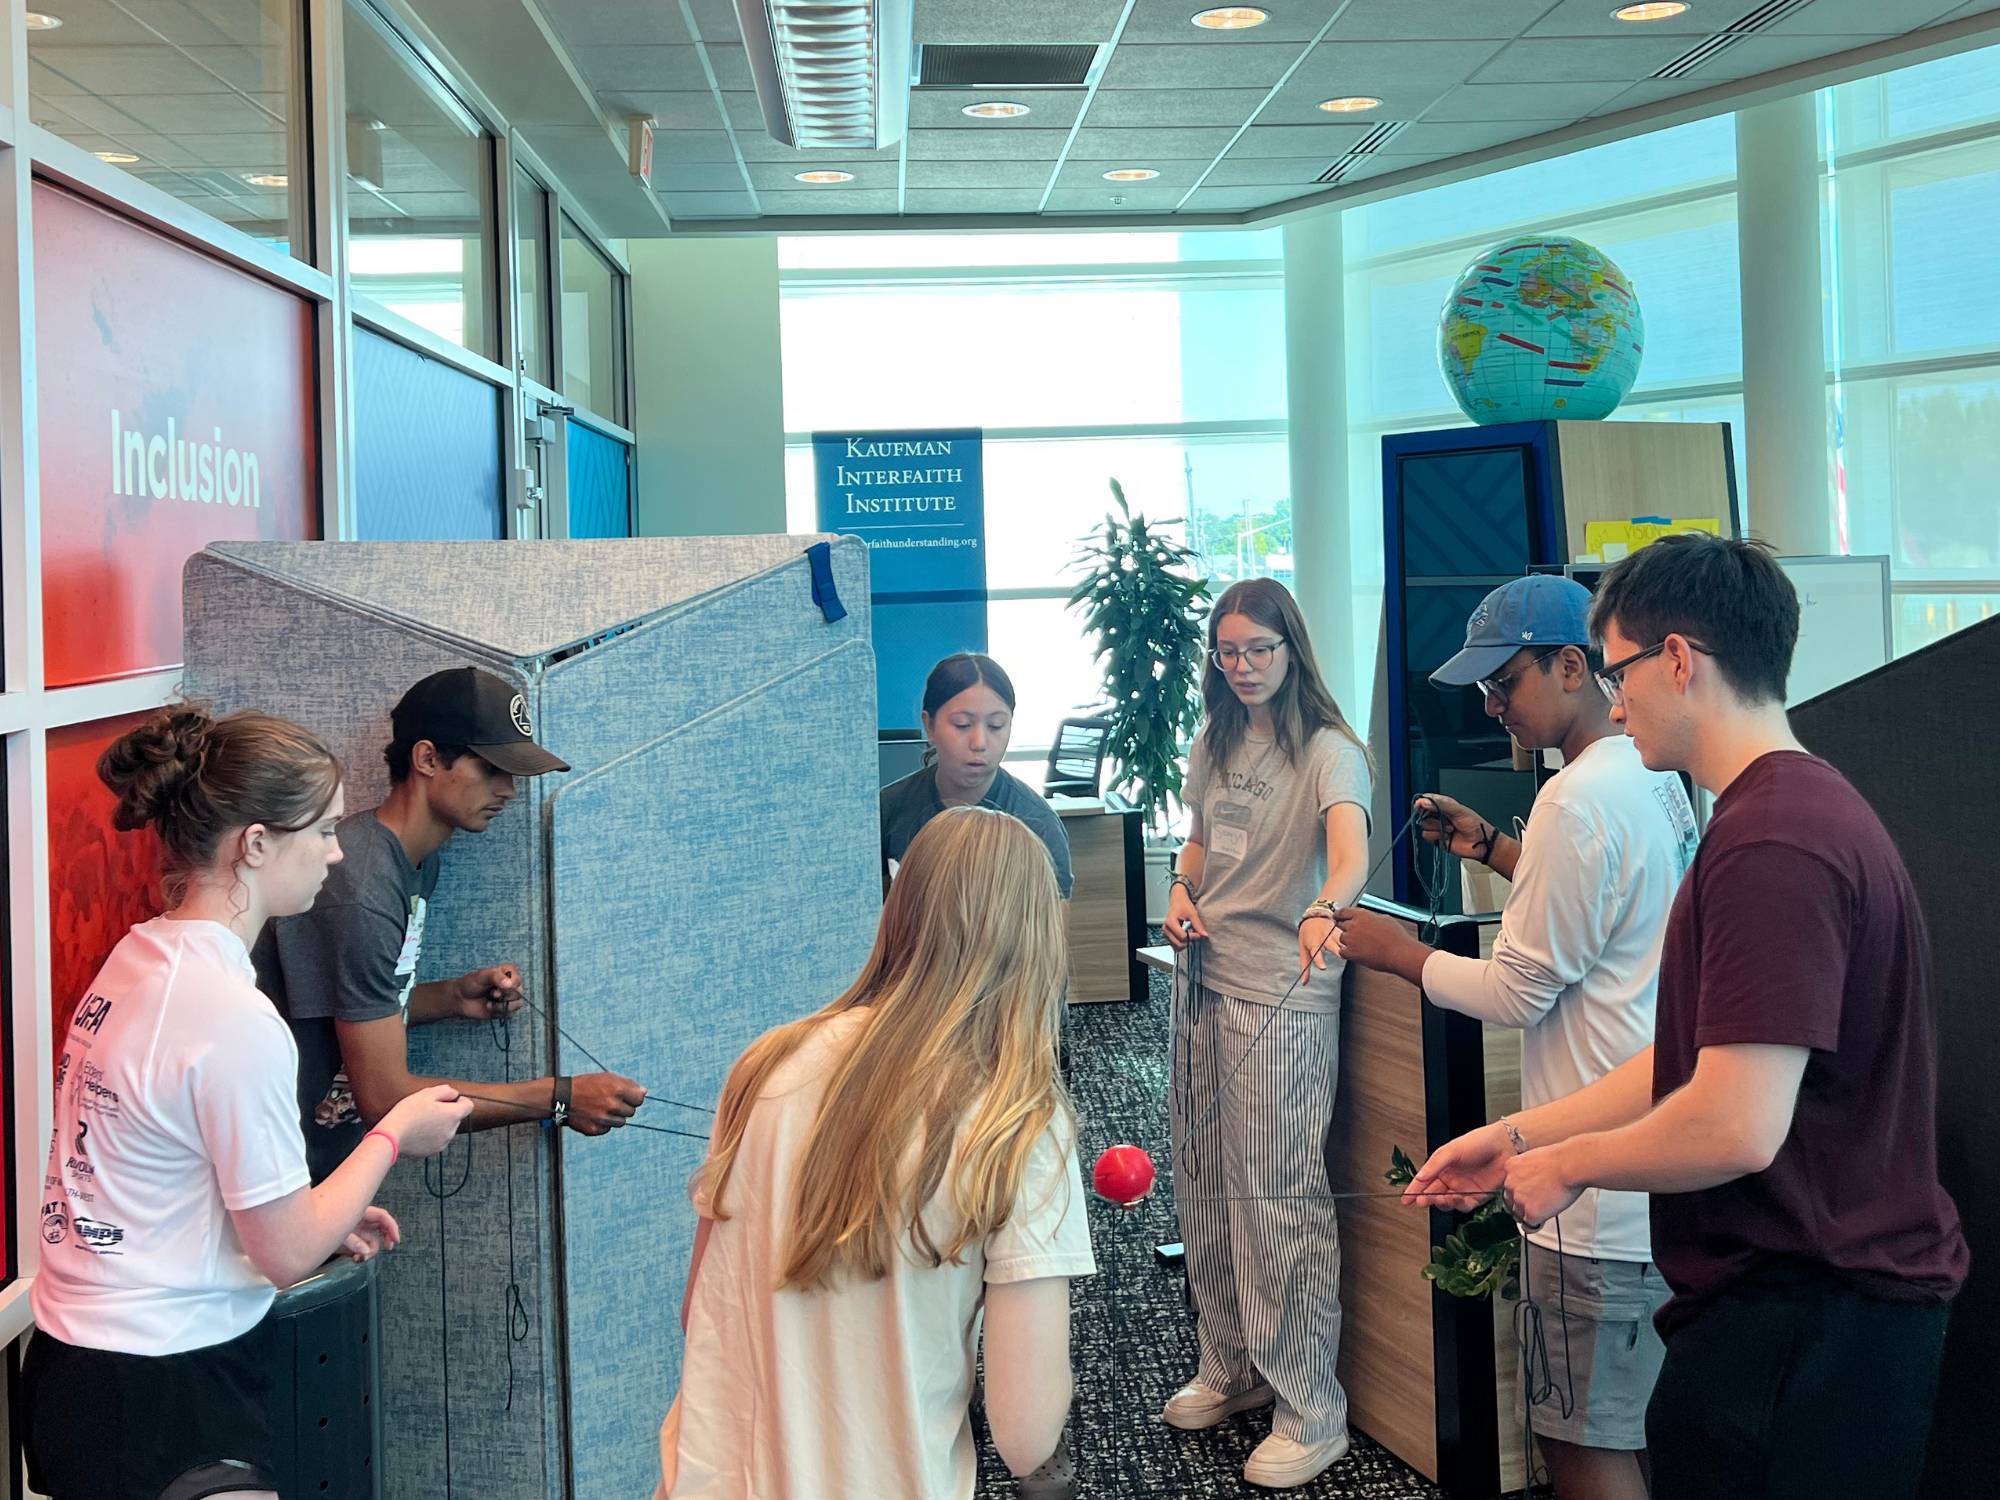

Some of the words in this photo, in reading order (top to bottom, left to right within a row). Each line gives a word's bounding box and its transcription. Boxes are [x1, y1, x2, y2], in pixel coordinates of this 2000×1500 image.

[111, 408, 260, 508] Inclusion
[845, 437, 952, 458] KAUFMAN
[836, 465, 963, 487] INTERFAITH
[846, 493, 957, 514] INSTITUTE
[867, 537, 977, 549] rfaithunderstanding.org
